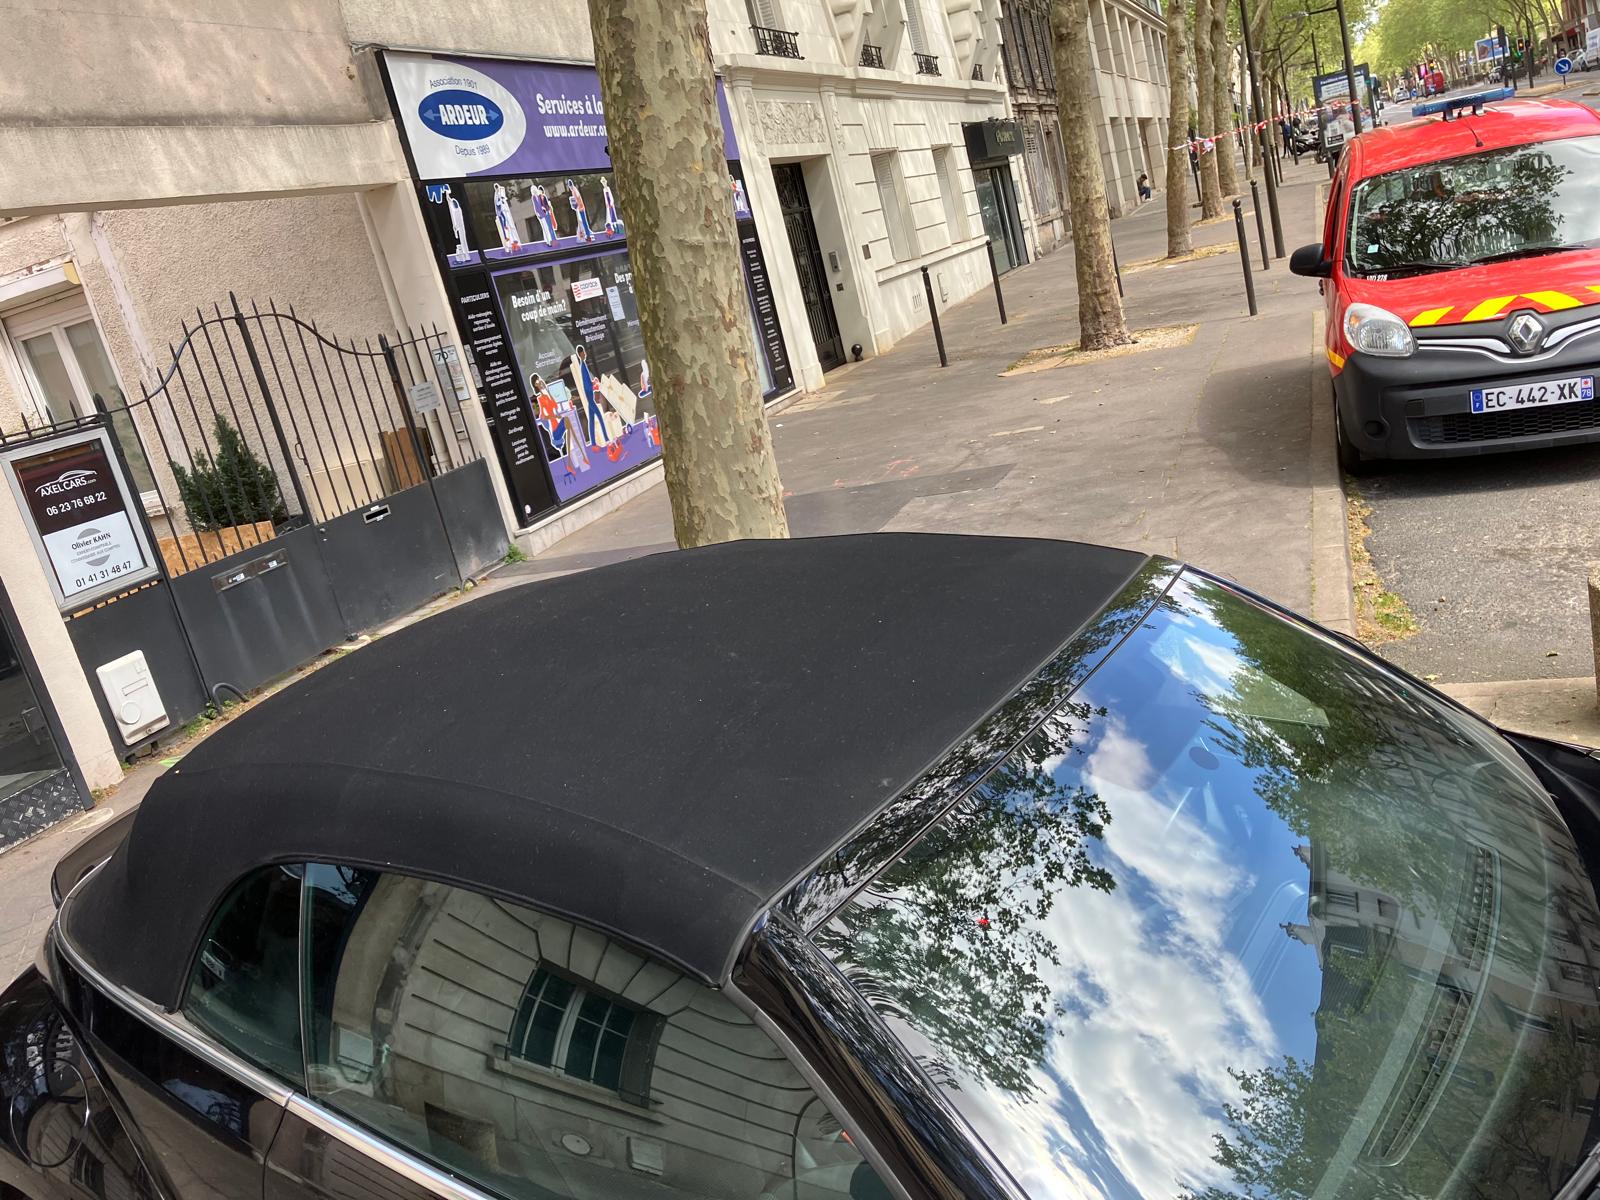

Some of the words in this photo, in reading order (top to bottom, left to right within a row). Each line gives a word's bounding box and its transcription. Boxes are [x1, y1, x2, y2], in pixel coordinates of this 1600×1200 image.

[438, 104, 490, 125] ARDEUR
[536, 93, 584, 114] Services
[585, 94, 593, 115] à
[455, 145, 476, 156] Depuis
[511, 291, 535, 308] Besoin
[536, 290, 551, 302] d'un
[521, 309, 538, 323] coup
[538, 304, 547, 317] de
[547, 299, 567, 315] main?
[434, 351, 449, 362] 70
[1485, 382, 1579, 409] EC-442-XK
[1581, 388, 1592, 398] 78
[46, 506, 59, 517] 06
[59, 501, 72, 512] 23
[71, 497, 84, 509] 76
[83, 494, 95, 505] 68
[95, 491, 107, 502] 22
[71, 538, 92, 551] Olivier
[92, 532, 111, 545] KAHN
[75, 577, 86, 588] 01
[88, 573, 99, 584] 41
[99, 568, 110, 580] 31
[111, 564, 122, 575] 48
[121, 560, 132, 571] 47
